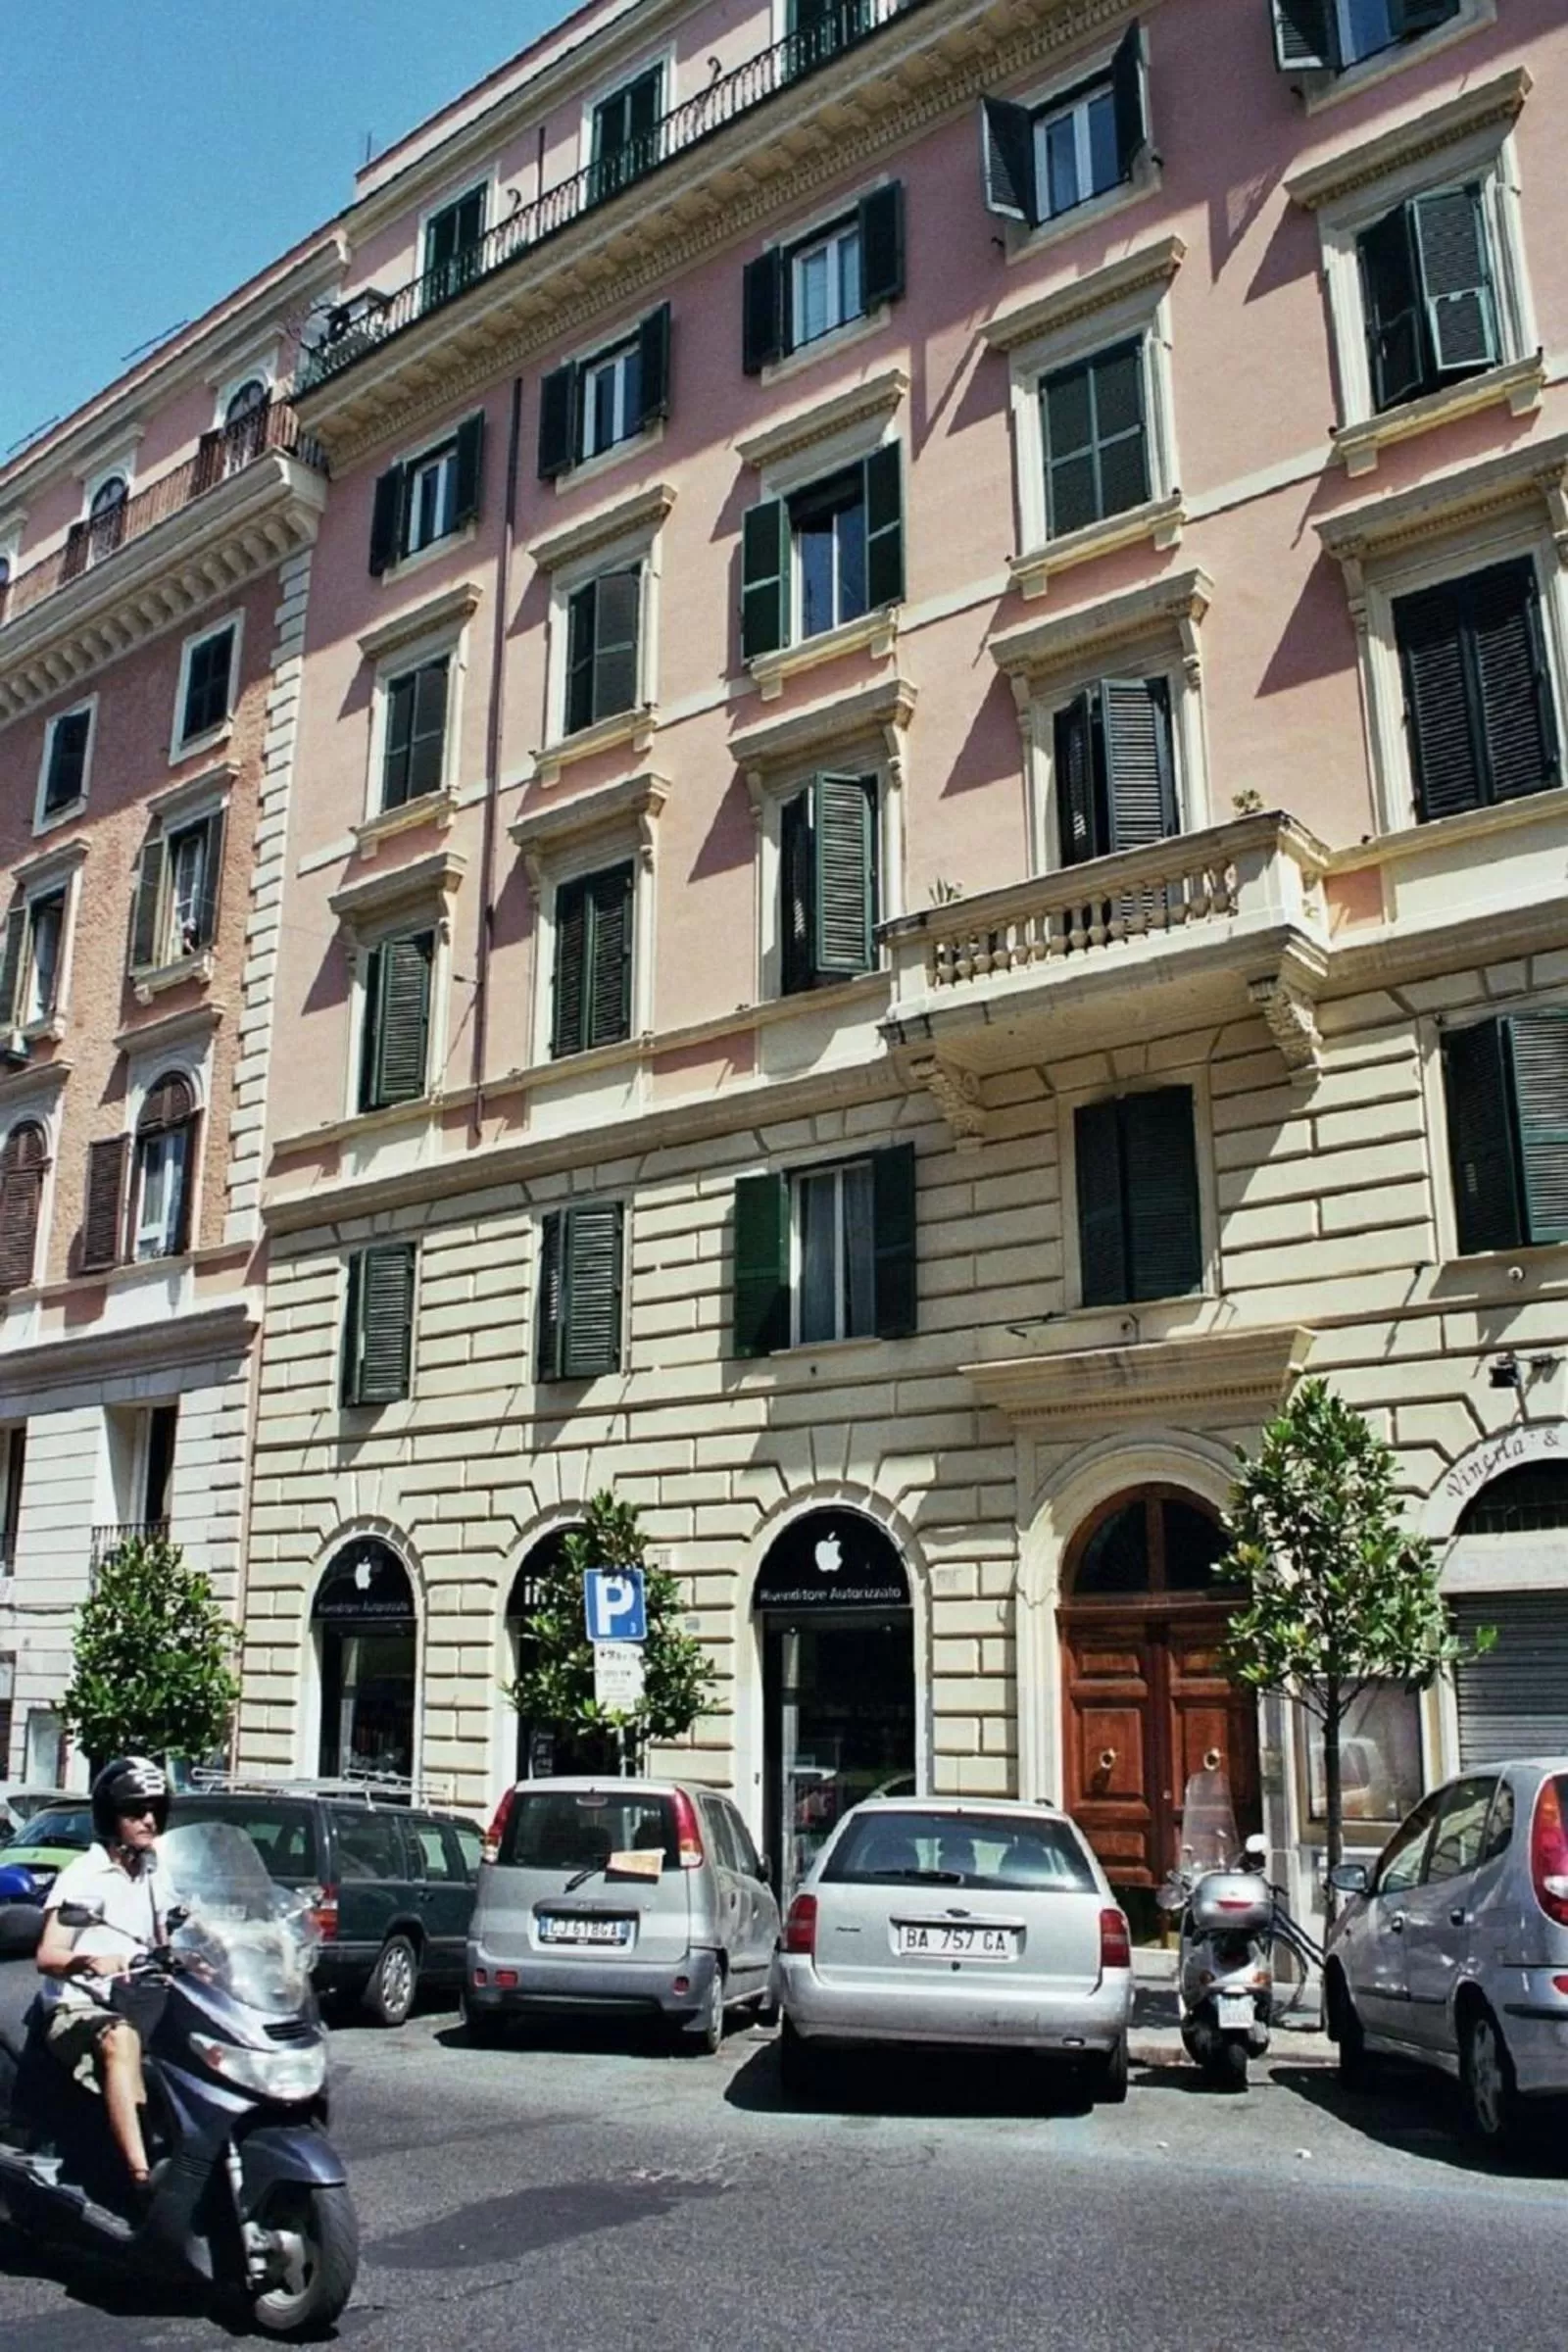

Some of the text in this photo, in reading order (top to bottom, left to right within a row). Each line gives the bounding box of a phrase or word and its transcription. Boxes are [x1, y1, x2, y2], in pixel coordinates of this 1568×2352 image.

[595, 1574, 635, 1636] P
[906, 1927, 929, 1948] BA
[940, 1928, 975, 1950] 757
